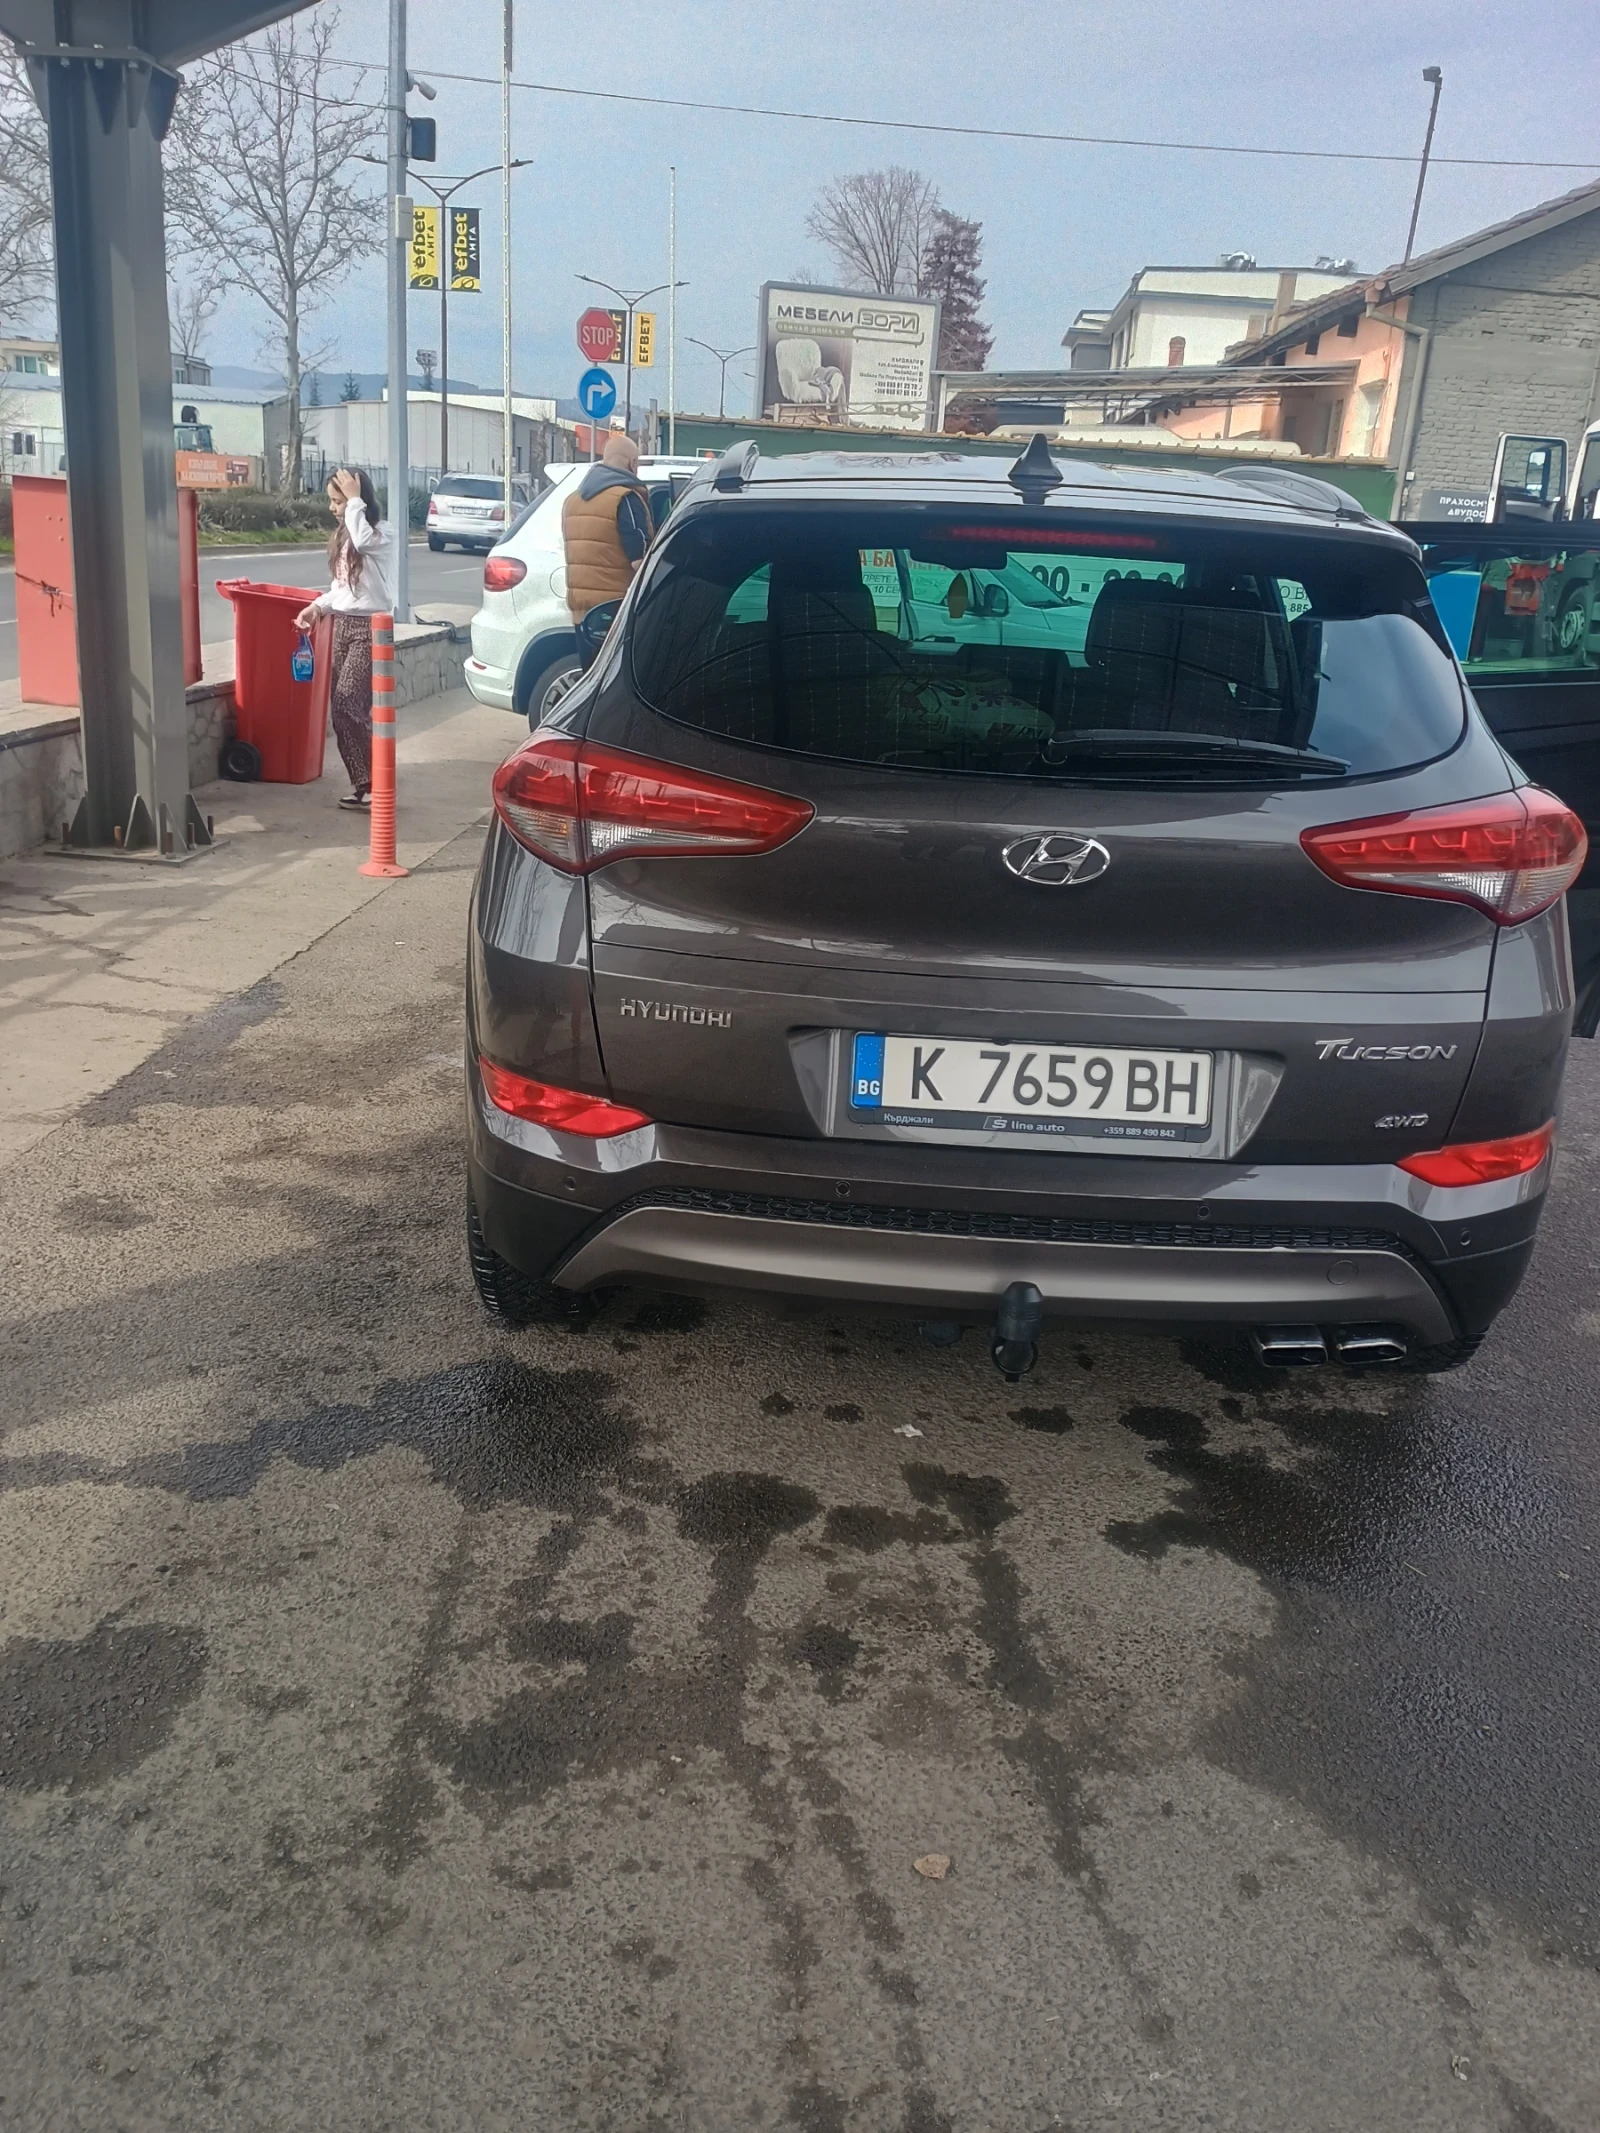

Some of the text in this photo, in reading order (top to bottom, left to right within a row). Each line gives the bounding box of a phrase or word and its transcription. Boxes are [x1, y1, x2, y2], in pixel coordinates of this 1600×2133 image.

[413, 211, 426, 269] efbet
[427, 225, 435, 258] ЛИГА
[454, 212, 468, 271] efbet
[468, 227, 477, 260] ЛИГА
[777, 304, 916, 331] МЕБЕЛИ ЗОРИ
[582, 325, 614, 346] STOP
[638, 315, 651, 363] EFBET
[620, 998, 732, 1028] HYUNDAI
[857, 1079, 880, 1095] BG
[911, 1046, 1199, 1115] K 7659 BH
[883, 1113, 934, 1125] Кърджали
[1011, 1120, 1034, 1131] line
[1035, 1121, 1066, 1133] auto
[1103, 1126, 1176, 1138] +359 889 490 842
[1374, 1112, 1429, 1129] 4WD
